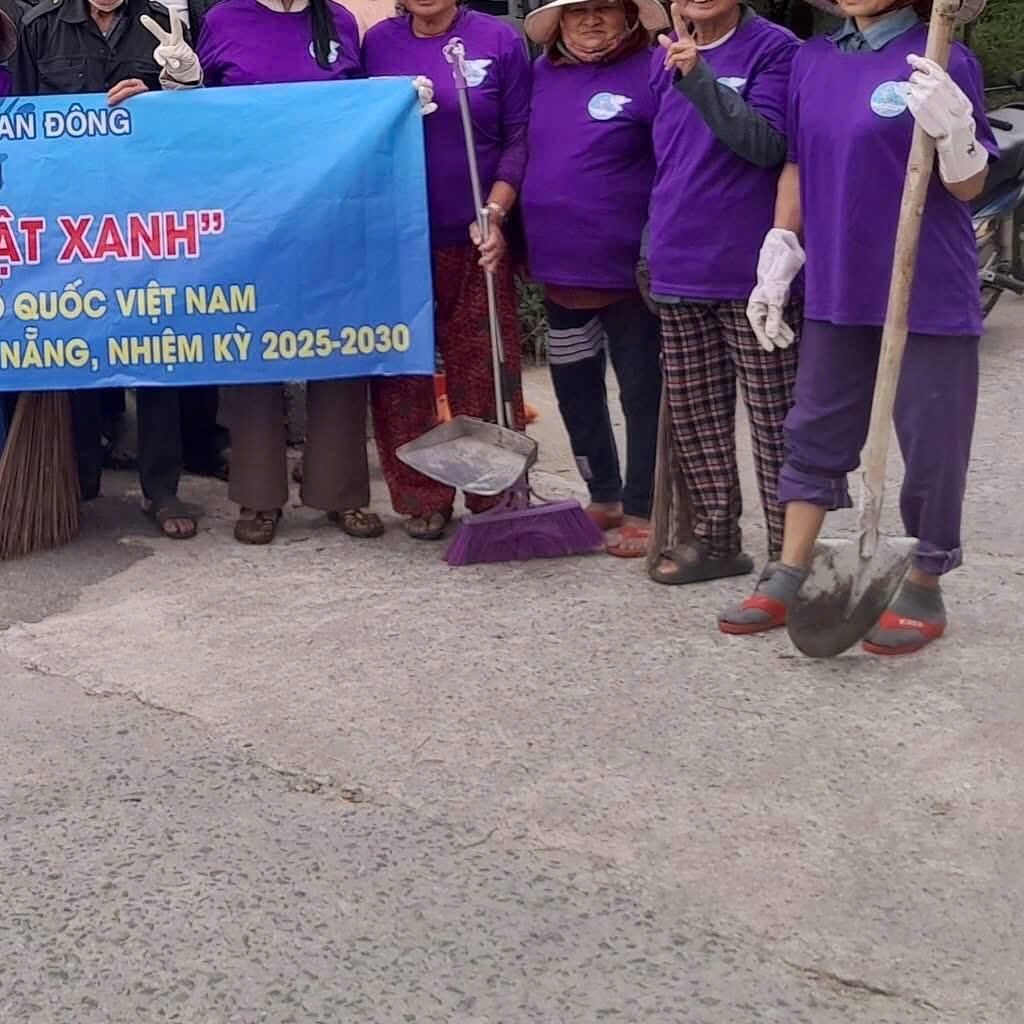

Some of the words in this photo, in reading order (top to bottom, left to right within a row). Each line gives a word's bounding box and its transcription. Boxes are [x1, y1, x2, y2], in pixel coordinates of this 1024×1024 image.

[44, 103, 131, 139] ĐÔNG
[13, 278, 107, 321] QUỐC
[115, 280, 176, 325] VIỆT
[185, 284, 257, 316] NAM
[0, 326, 99, 371] NẴNG,
[107, 327, 204, 372] NHIỆM
[213, 324, 252, 362] KỲ
[261, 323, 411, 361] 2025-2030
